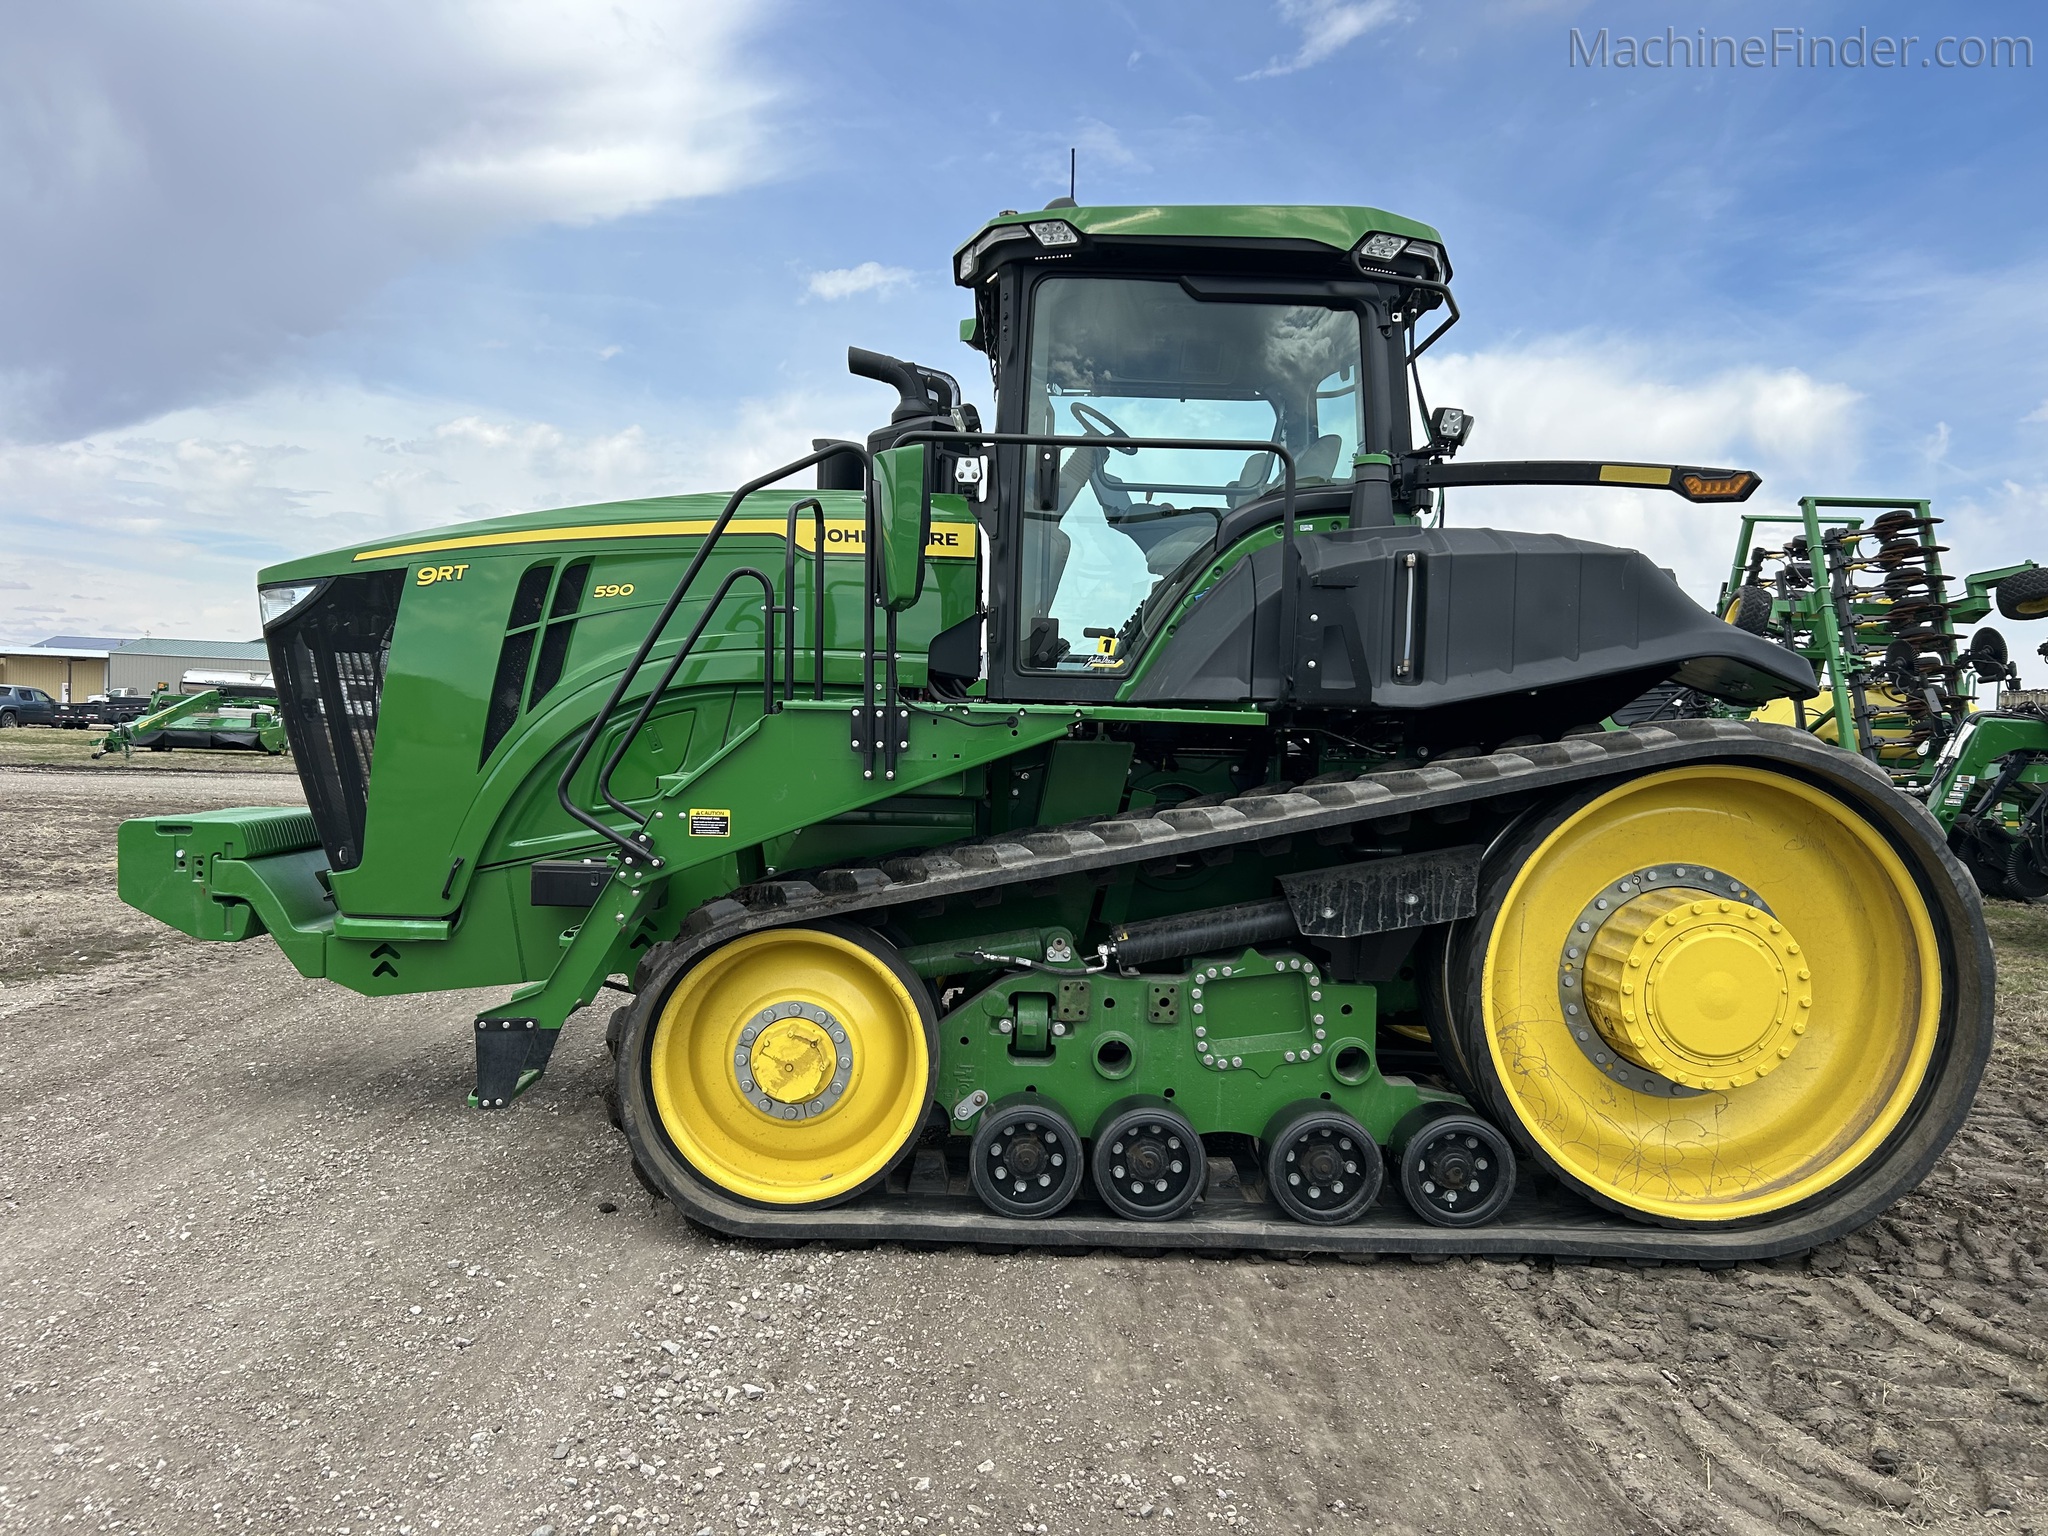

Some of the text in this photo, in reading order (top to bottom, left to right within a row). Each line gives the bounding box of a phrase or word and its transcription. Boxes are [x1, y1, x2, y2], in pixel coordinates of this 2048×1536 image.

[416, 564, 470, 586] 9RT
[593, 583, 635, 598] 590
[1103, 639, 1112, 653] 1
